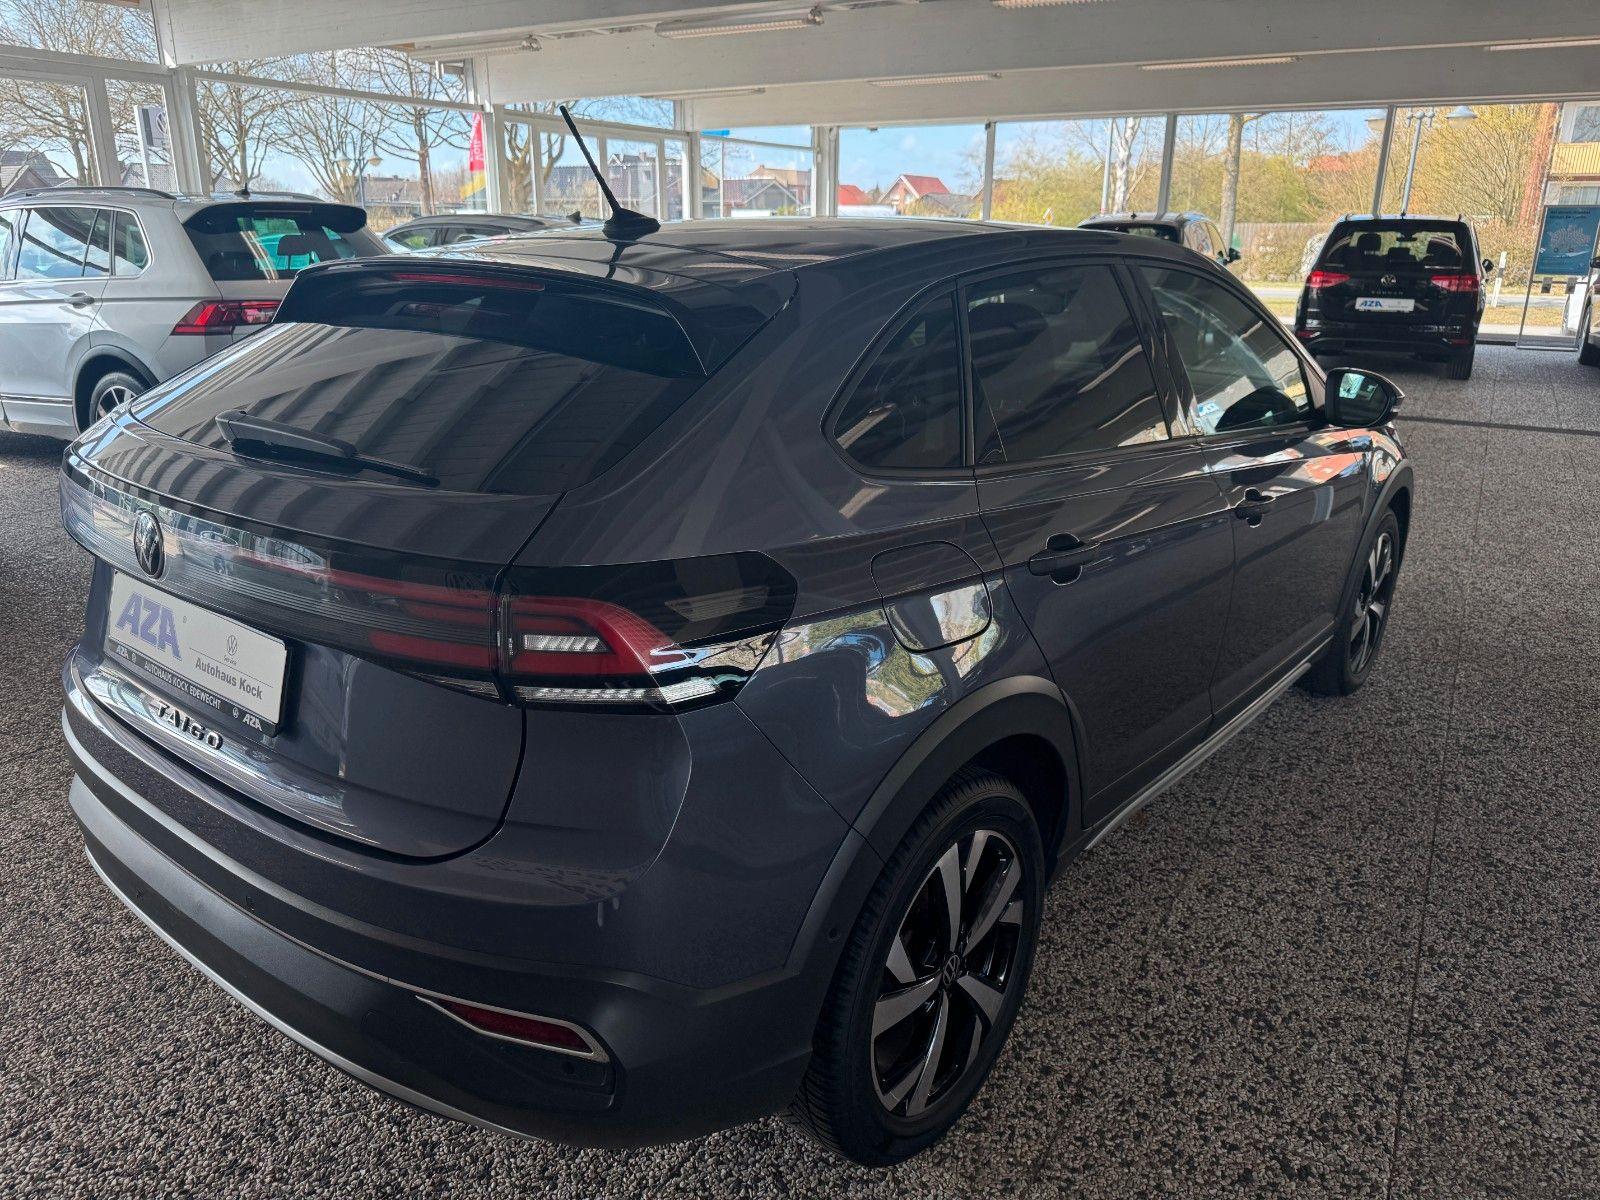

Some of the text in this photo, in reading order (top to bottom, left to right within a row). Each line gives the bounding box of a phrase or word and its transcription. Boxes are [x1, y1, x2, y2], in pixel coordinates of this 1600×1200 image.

[116, 593, 181, 660] AZA
[116, 644, 129, 660] AZA
[172, 676, 189, 693] KOCK
[189, 681, 222, 710] EDEWECHT
[242, 713, 263, 732] AZA
[195, 657, 263, 700] Autohaus Kock
[154, 700, 224, 750] TAIGO
